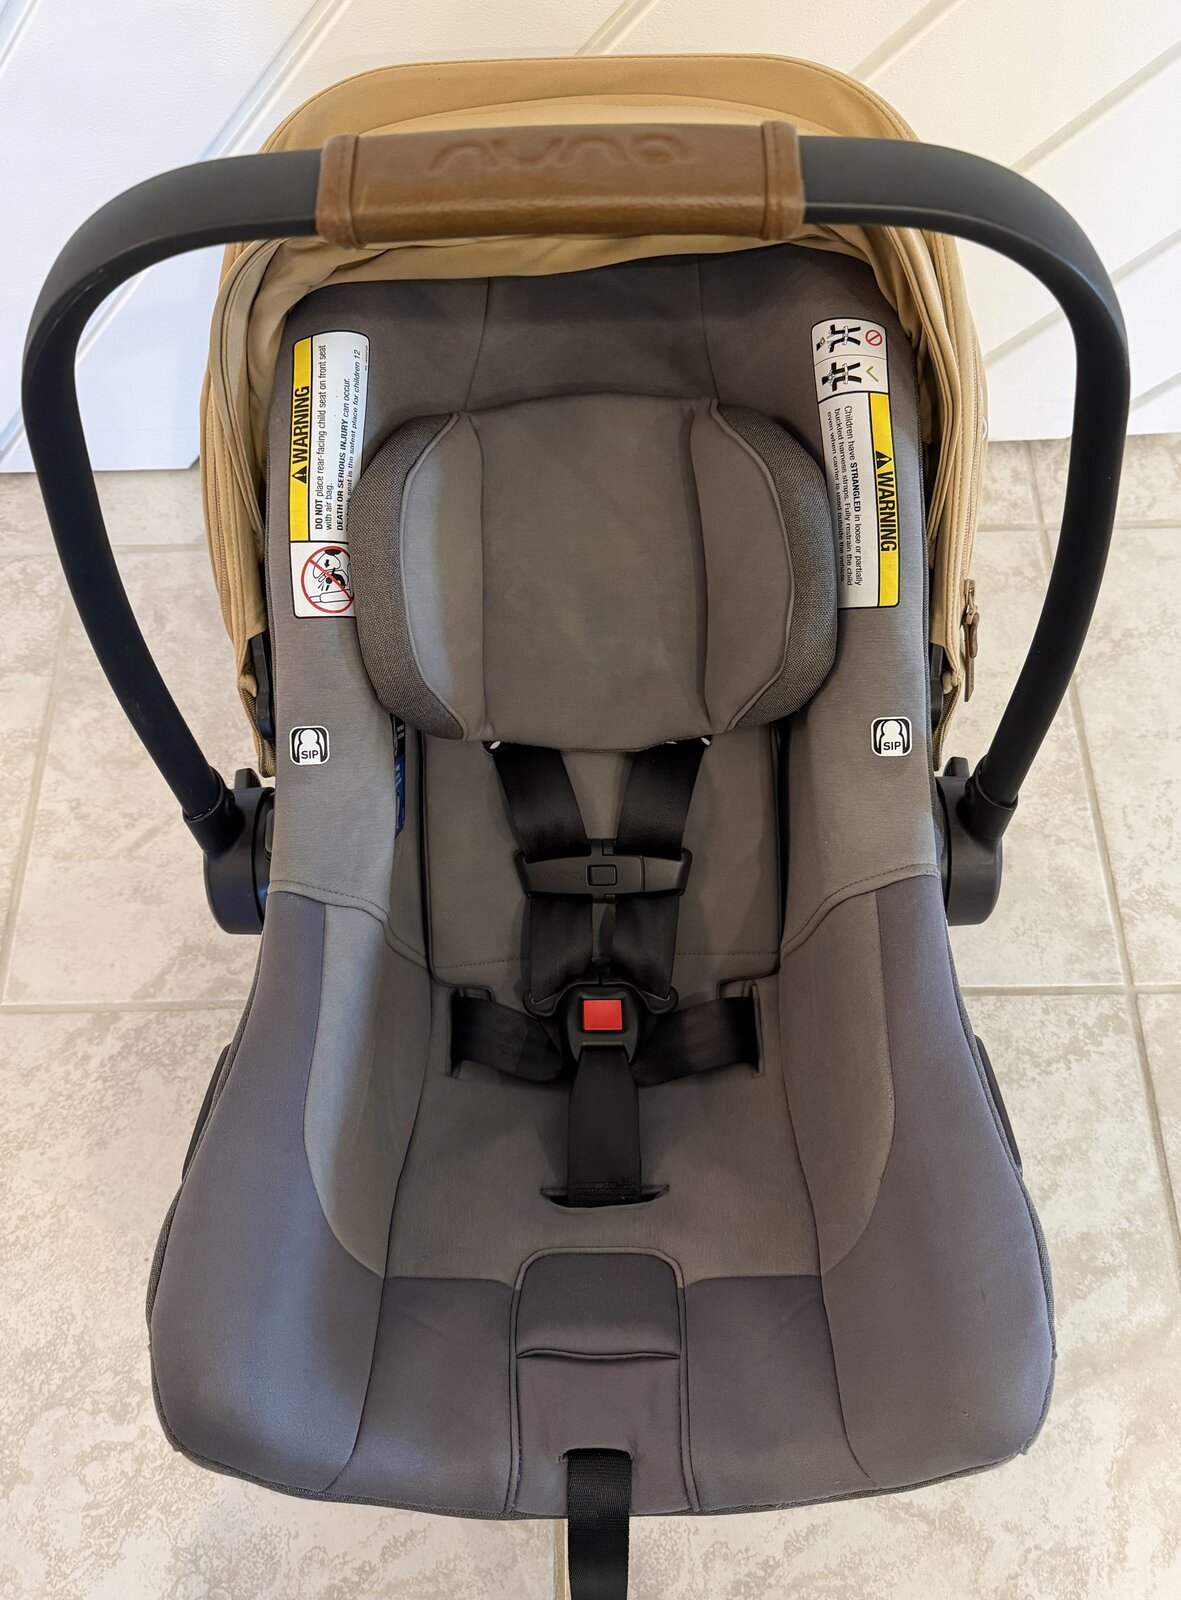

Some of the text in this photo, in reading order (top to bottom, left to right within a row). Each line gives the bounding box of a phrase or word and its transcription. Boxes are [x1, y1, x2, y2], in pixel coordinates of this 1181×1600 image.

[291, 386, 310, 465] WARNING
[347, 470, 353, 478] is
[353, 349, 360, 360] 12
[834, 407, 844, 441] buckled
[844, 405, 854, 440] Children
[314, 345, 327, 530] DO NOT place rear-facing child seat on front seat
[340, 419, 349, 451] INJURY
[838, 441, 848, 473] harness
[847, 441, 856, 461] have
[337, 452, 346, 489] SERIOUS
[832, 455, 840, 481] carrier
[325, 483, 334, 500] bag.
[337, 490, 344, 502] OR
[841, 474, 850, 501] straps.
[850, 462, 861, 512] STRANGLED
[324, 514, 332, 531] with
[844, 503, 852, 521] Fully
[877, 471, 897, 552] WARNING
[845, 523, 853, 552] restrain
[855, 545, 862, 553] or
[854, 555, 863, 586] partially
[301, 749, 319, 759] SIP
[882, 741, 901, 750] SIP
